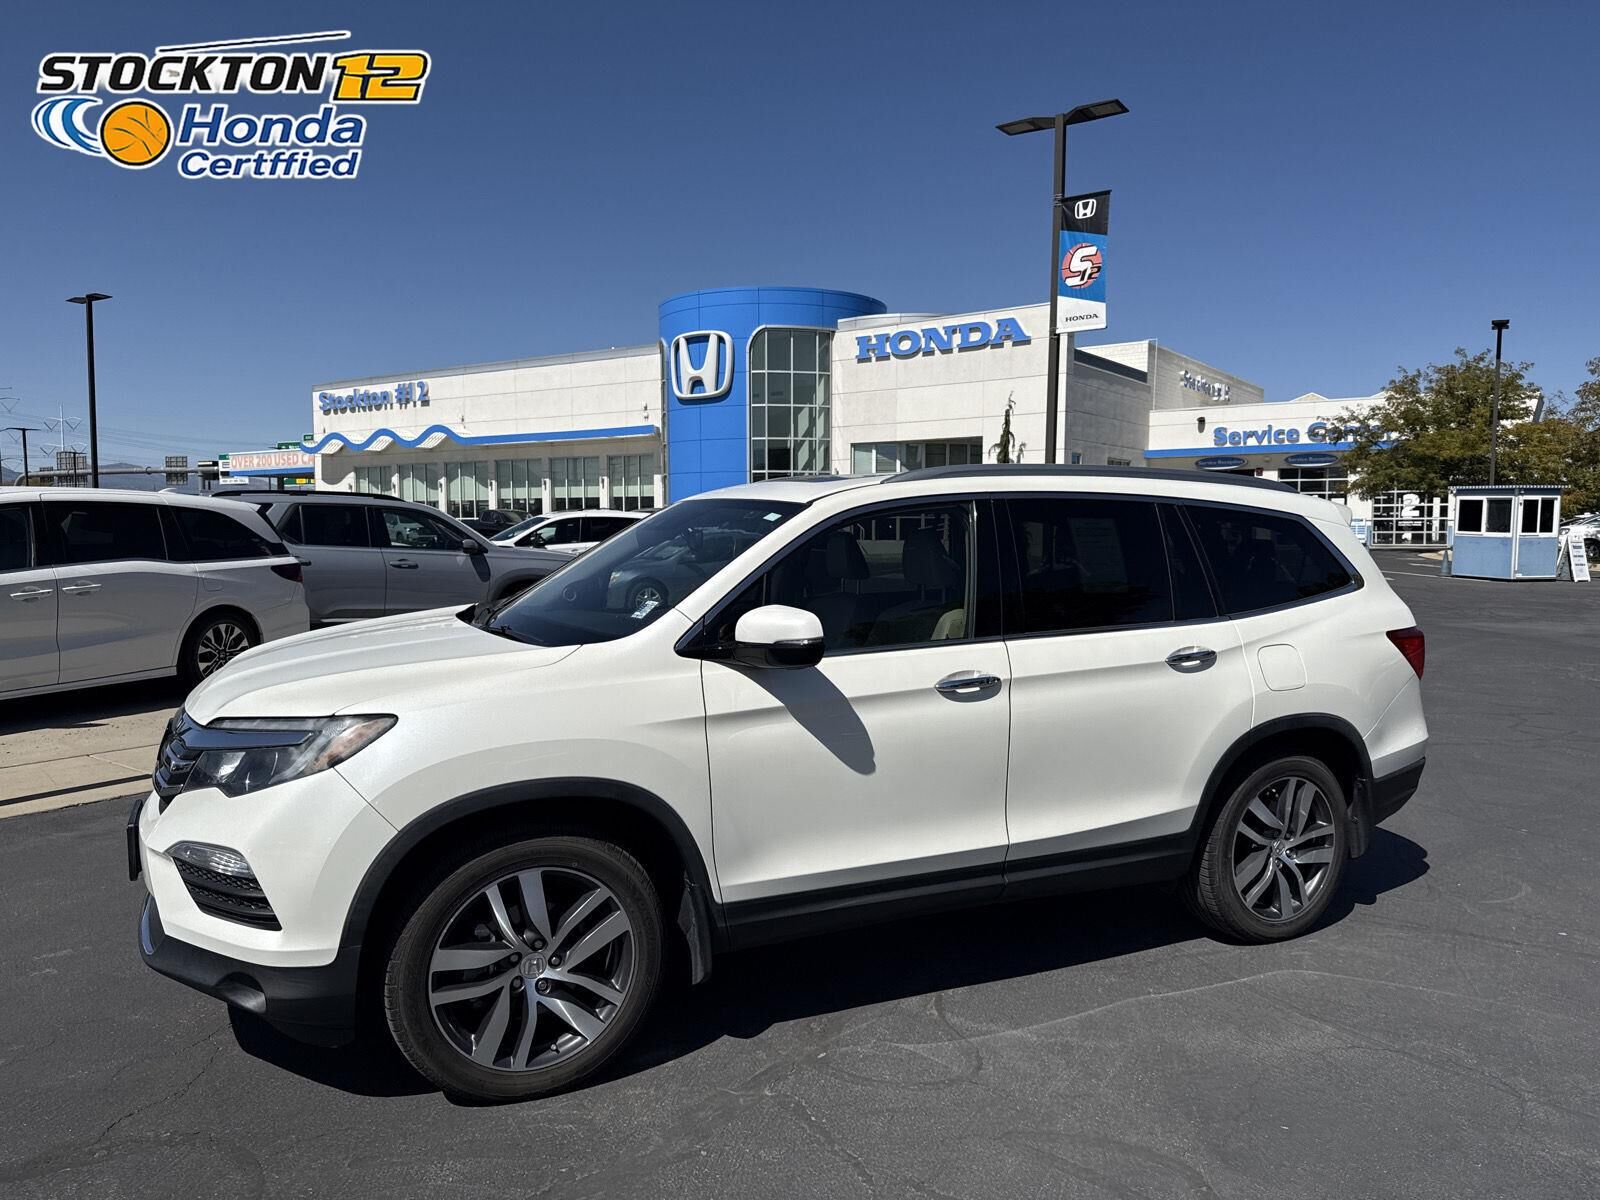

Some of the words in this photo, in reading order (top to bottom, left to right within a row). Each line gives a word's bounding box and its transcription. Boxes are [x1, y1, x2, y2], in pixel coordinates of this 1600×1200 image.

[1065, 313, 1099, 323] HONDA
[854, 316, 1033, 363] HONDA
[318, 387, 391, 413] Stockton
[395, 381, 430, 406] #12
[1213, 424, 1300, 447] Service
[230, 454, 254, 469] OVER
[256, 453, 272, 468] 200
[274, 452, 299, 467] USED
